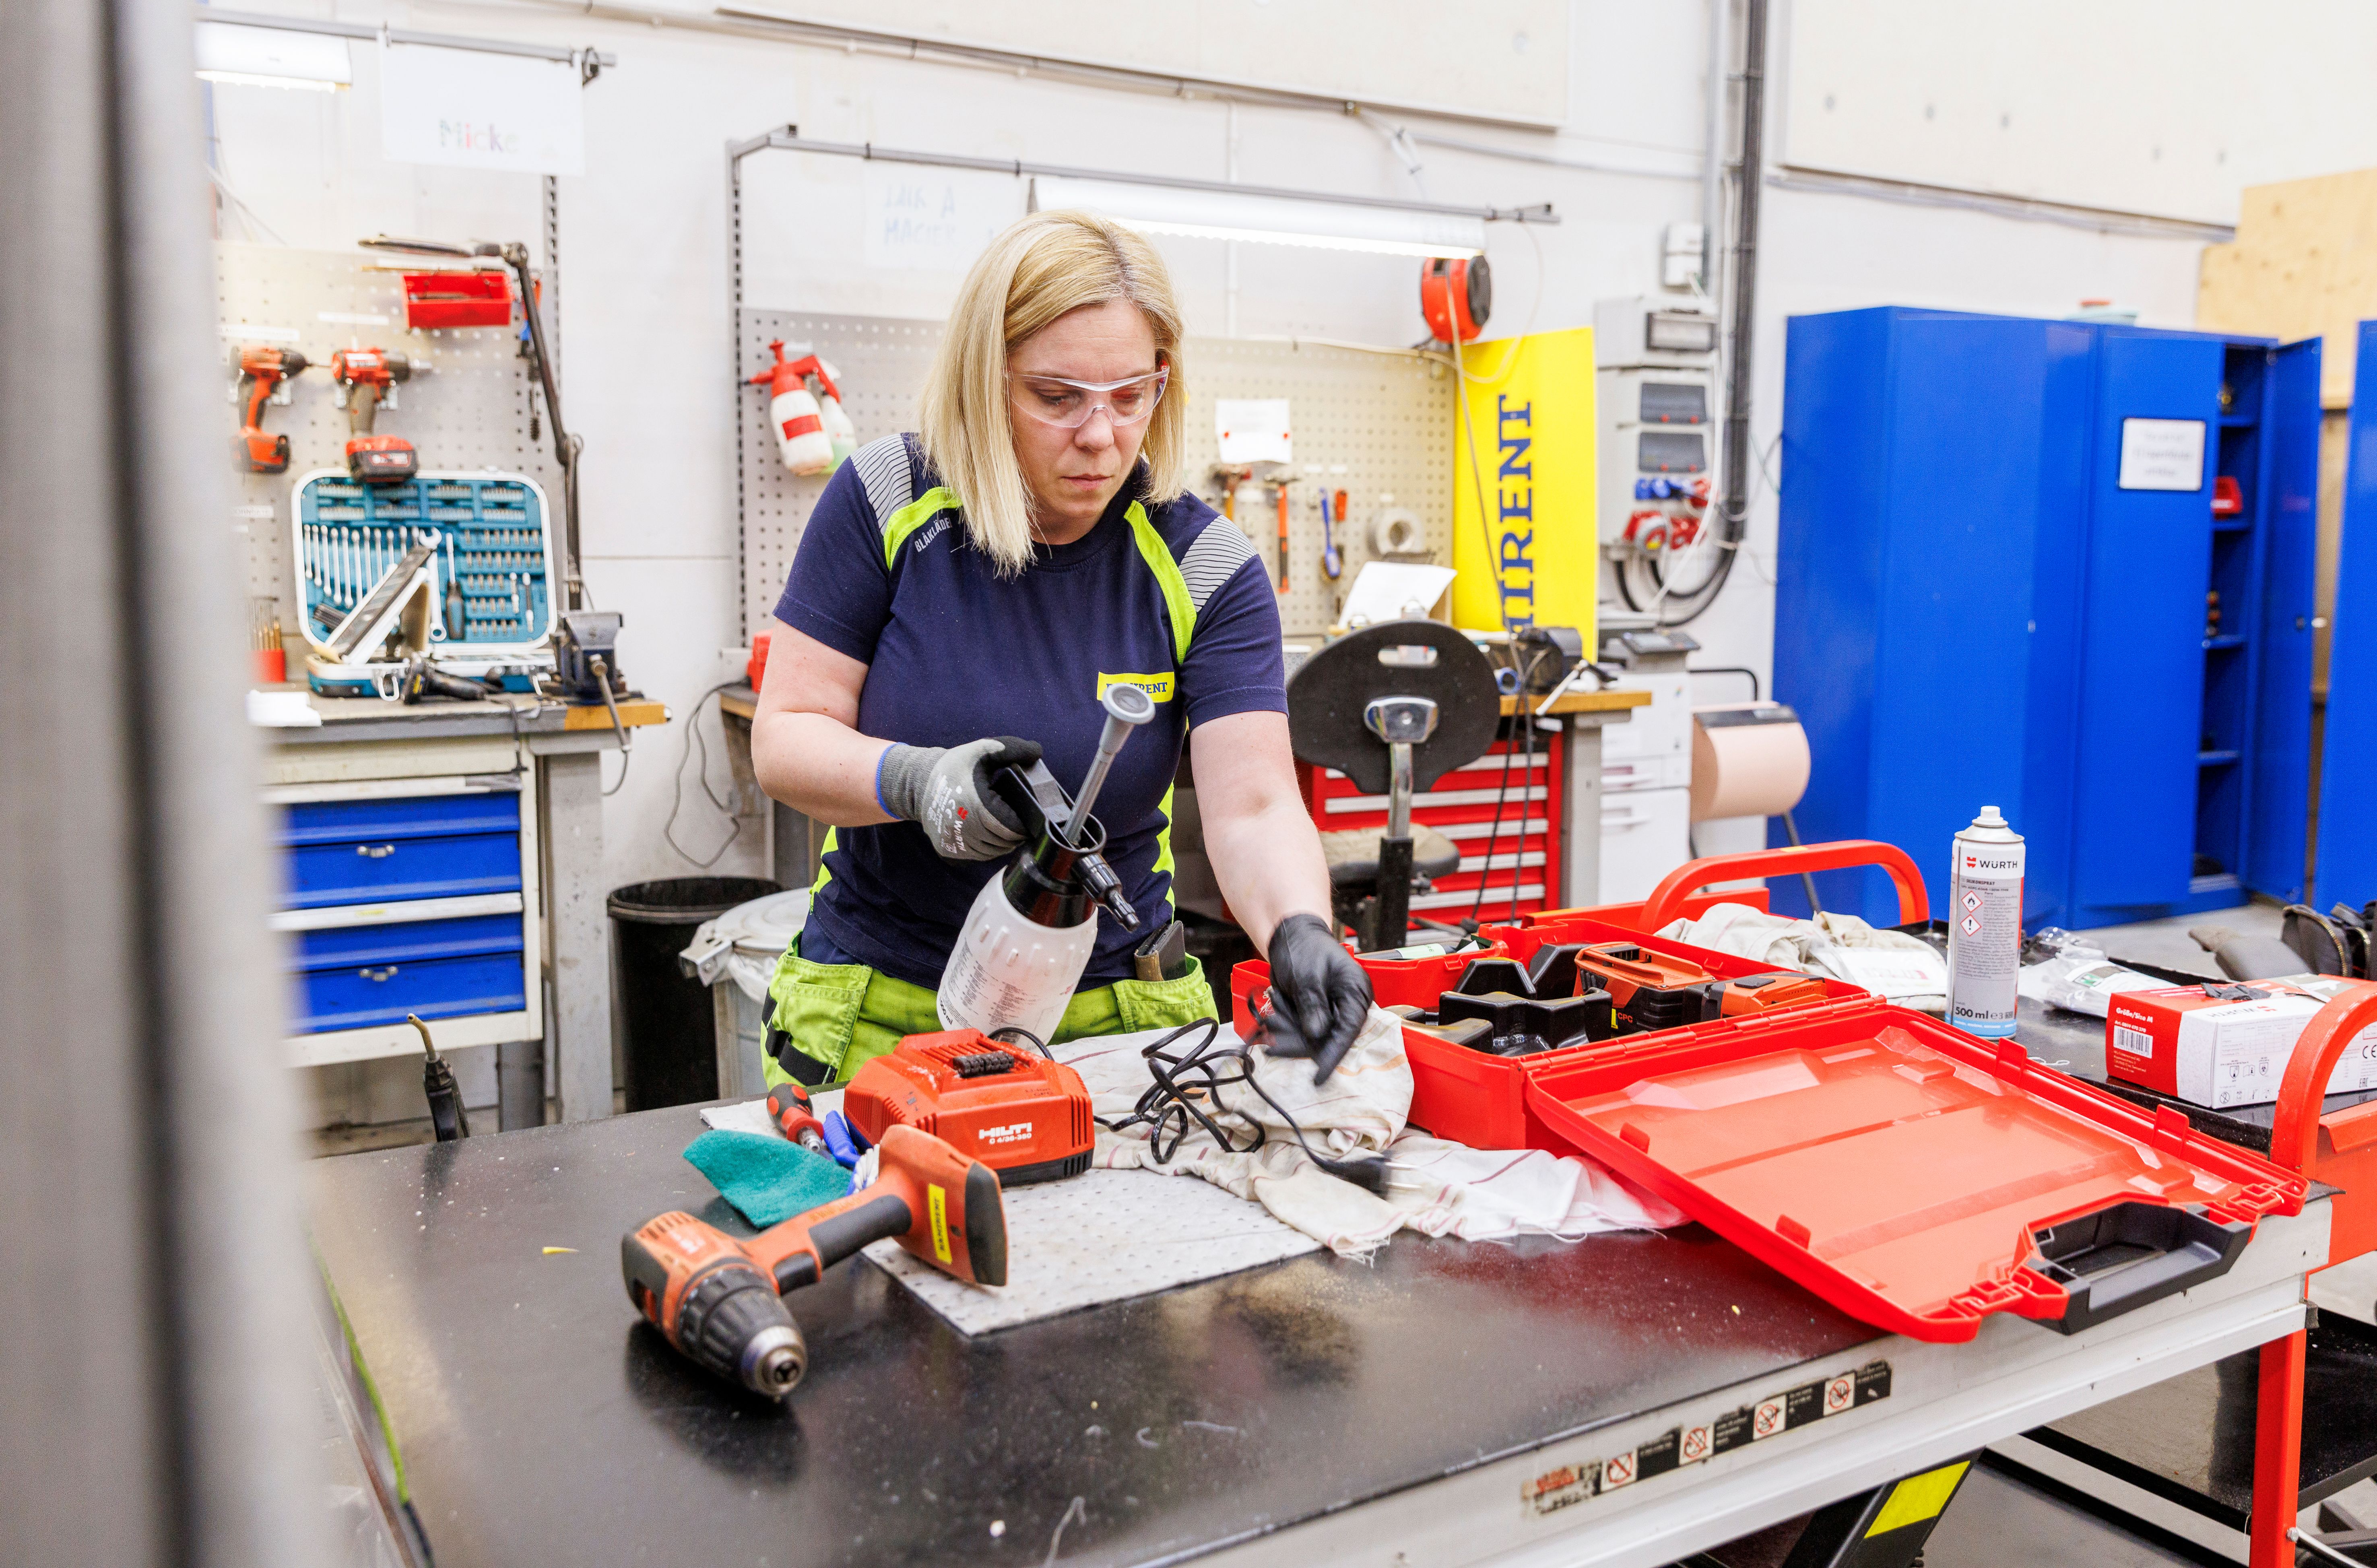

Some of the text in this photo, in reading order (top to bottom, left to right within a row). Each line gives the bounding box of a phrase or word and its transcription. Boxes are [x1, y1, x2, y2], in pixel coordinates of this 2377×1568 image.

[914, 518, 952, 553] BLÅKLÄDE
[1980, 860, 2018, 869] WÜRTH
[1618, 1012, 1633, 1023] CPC
[1955, 1007, 1973, 1017] 500
[1975, 1011, 1988, 1019] ml
[979, 1122, 1032, 1139] HILTI
